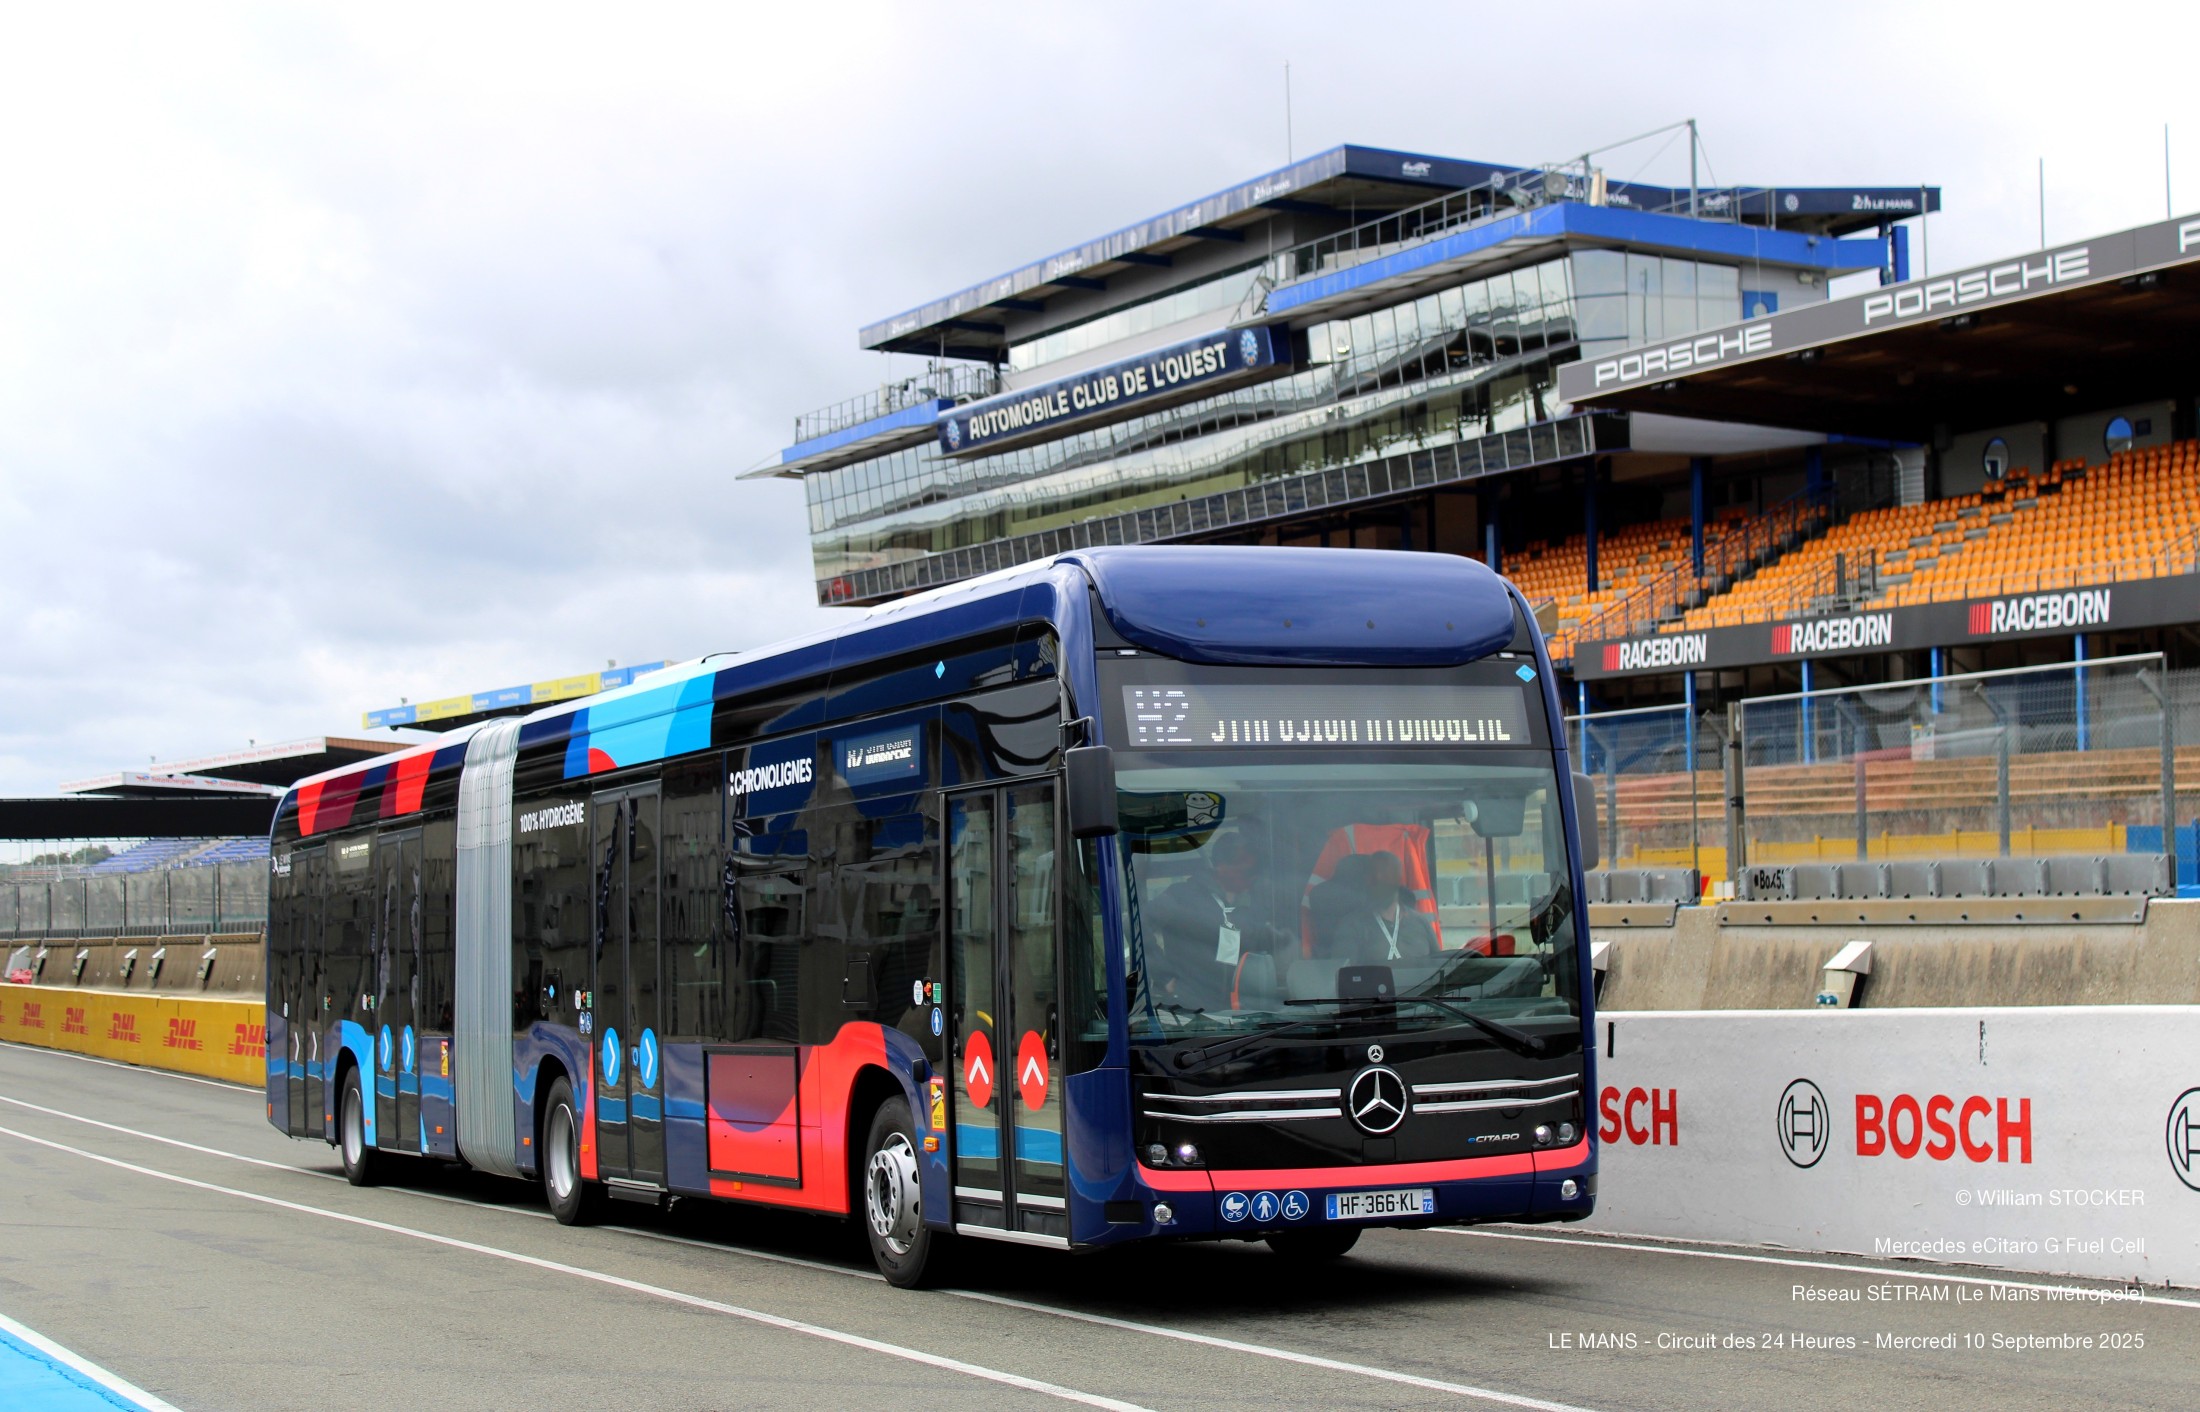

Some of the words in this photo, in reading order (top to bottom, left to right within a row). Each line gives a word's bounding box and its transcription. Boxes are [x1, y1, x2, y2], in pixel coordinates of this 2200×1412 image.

[1864, 247, 2090, 325] PORSCHE
[1595, 322, 1772, 388] PORSCHE
[969, 390, 1071, 440] AUTOMOBILE
[1073, 378, 1119, 410] CLUB
[1123, 367, 1148, 396] DE
[1152, 342, 1227, 387] L'OUEST
[1991, 589, 2110, 634] RACEBORN
[1619, 634, 1707, 670] RACEBORN
[1791, 613, 1892, 654] RACEBORN
[520, 812, 539, 833] 100%
[540, 799, 585, 830] HYDROGÈNE
[20, 1002, 45, 1028] DHL
[61, 1007, 88, 1035] DHL
[107, 1013, 141, 1043] DHL
[163, 1018, 202, 1051] DHL
[1599, 1086, 1678, 1145] SCH
[1856, 1094, 2032, 1163] BOSCH
[1340, 1193, 1420, 1215] HF-366-KL
[1423, 1201, 1433, 1210] 72
